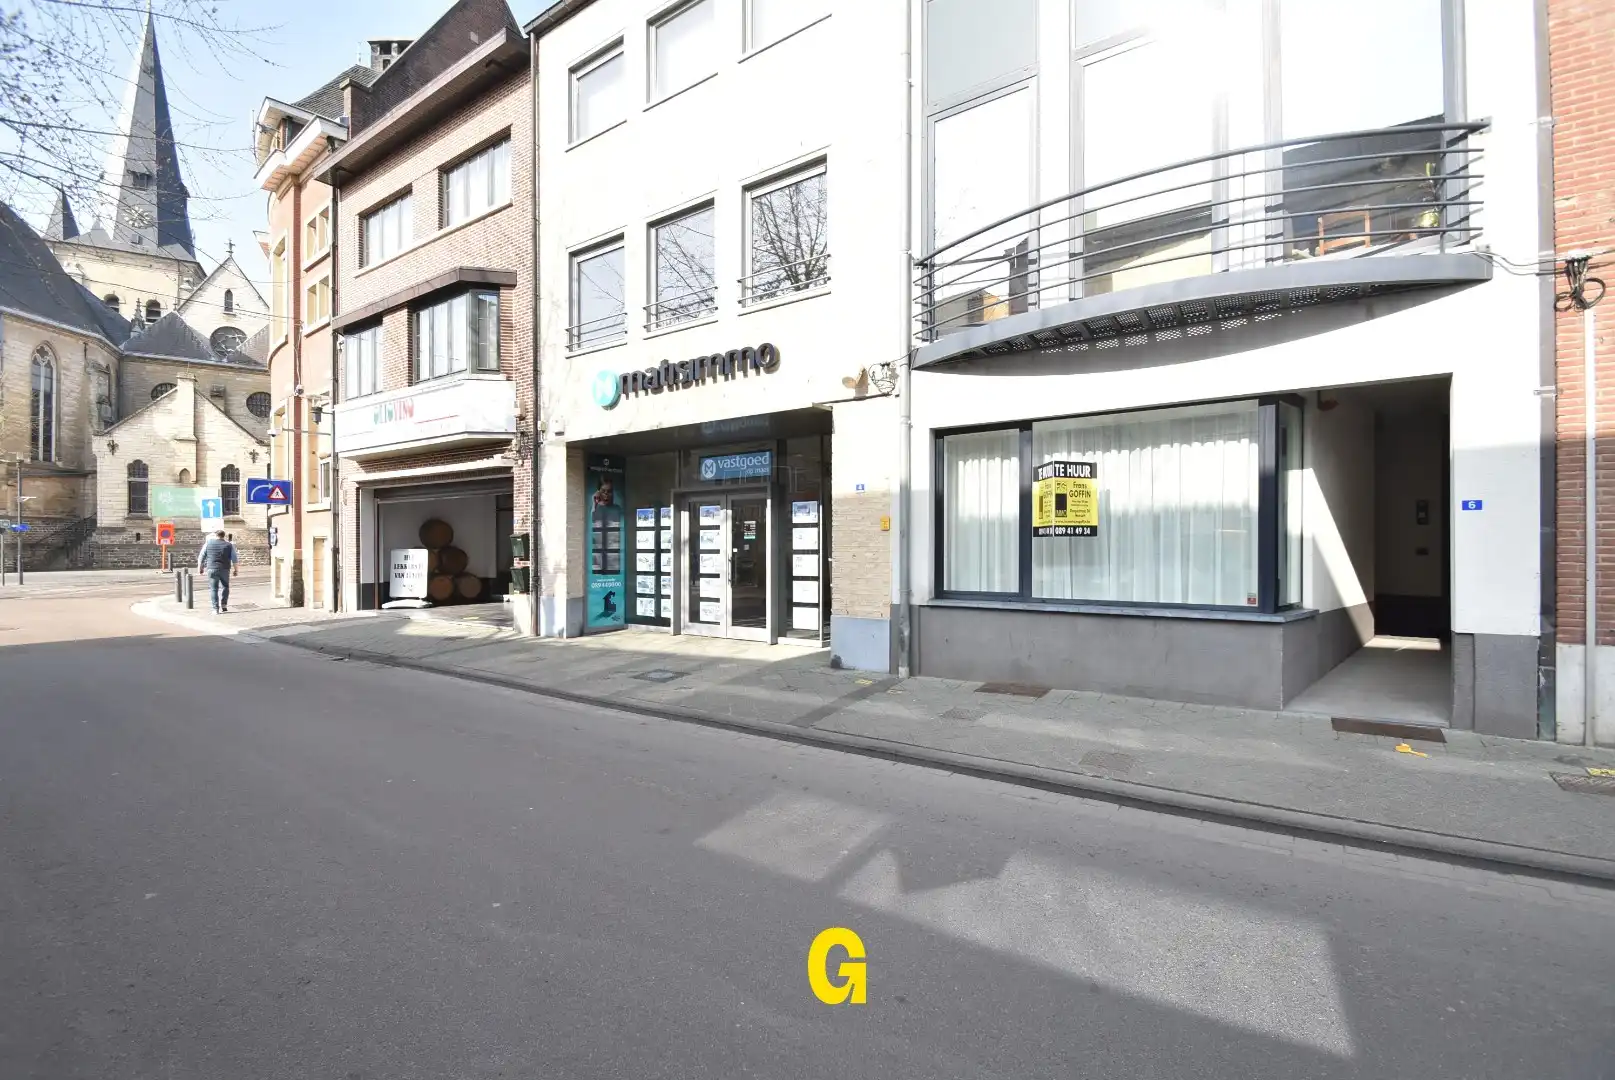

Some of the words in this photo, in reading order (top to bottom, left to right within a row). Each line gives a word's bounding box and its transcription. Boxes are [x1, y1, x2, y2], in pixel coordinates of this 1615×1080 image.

[618, 343, 777, 394] matisimmo
[718, 451, 769, 470] vastgoed
[1055, 464, 1065, 477] TE
[1067, 465, 1091, 478] HUUR
[1069, 490, 1091, 498] GOFFIN
[1468, 501, 1476, 509] 6
[1055, 527, 1066, 535] 089
[1067, 527, 1074, 535] 41
[1075, 527, 1082, 535] 49
[1084, 527, 1091, 535] 34
